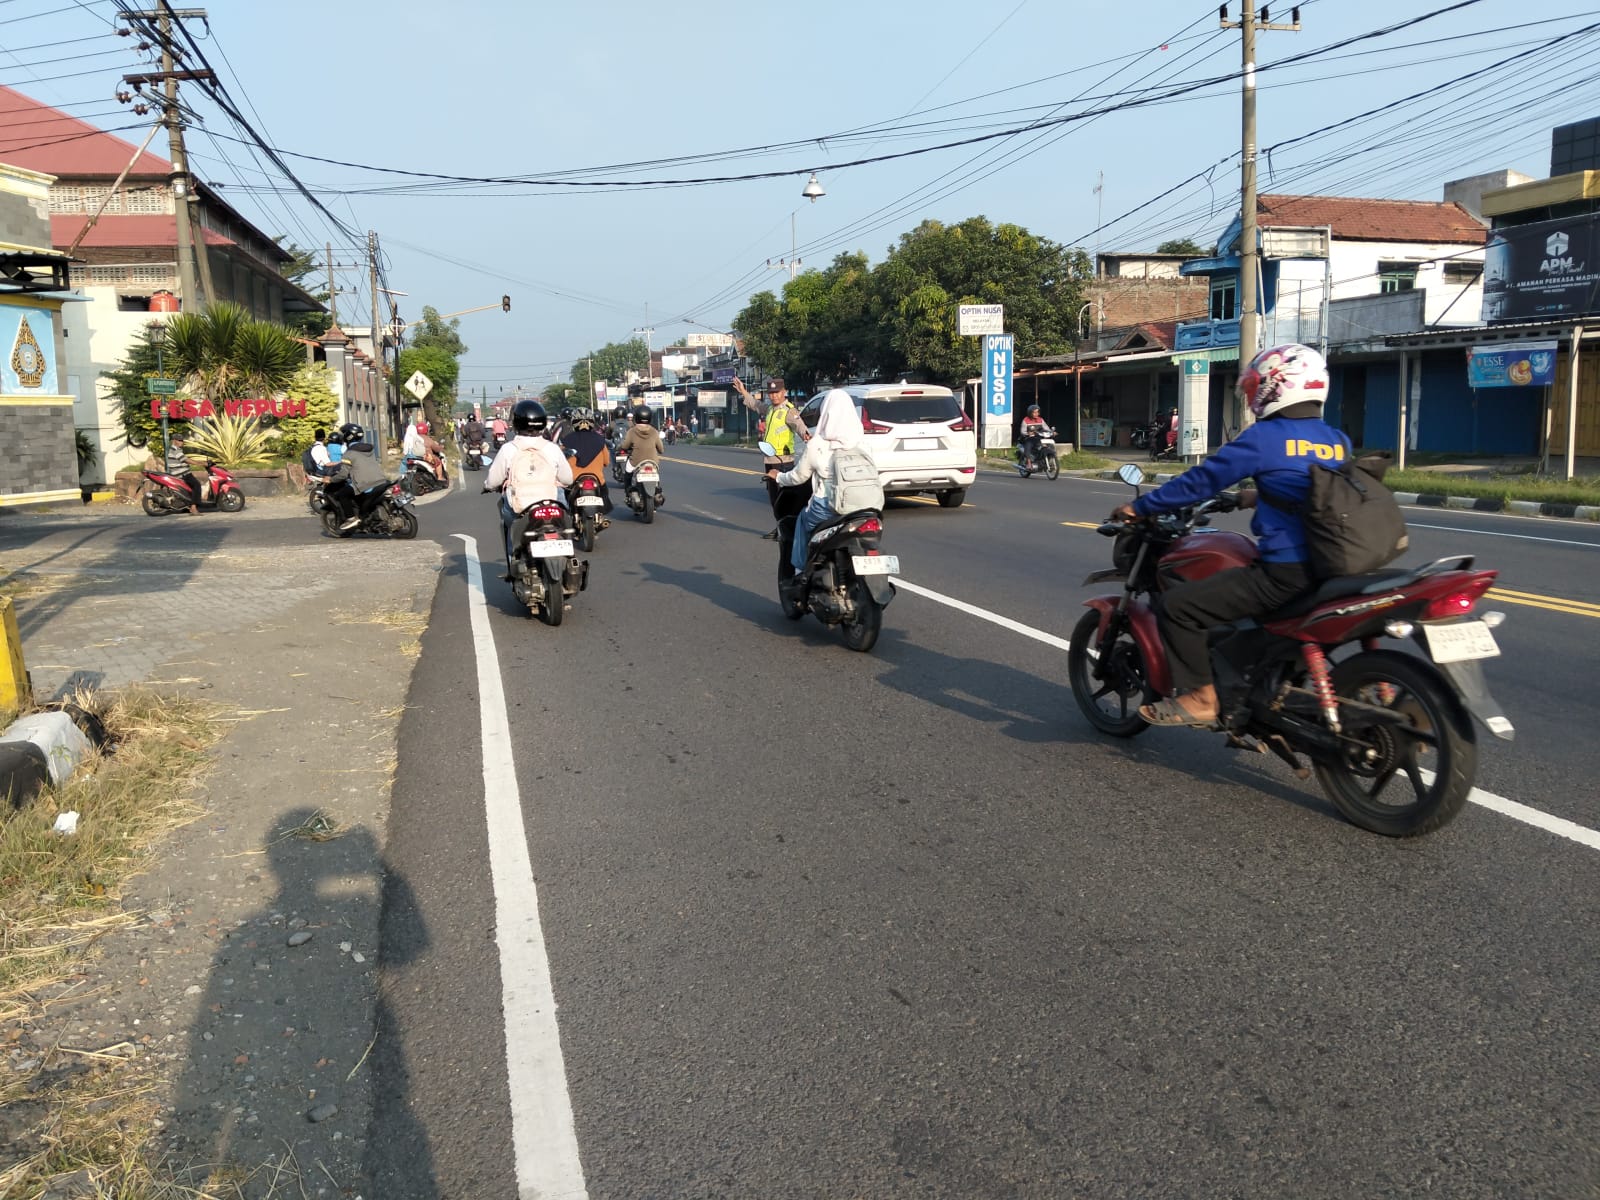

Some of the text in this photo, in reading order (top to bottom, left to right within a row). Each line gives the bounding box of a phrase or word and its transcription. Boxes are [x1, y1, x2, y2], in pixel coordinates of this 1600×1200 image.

[1540, 257, 1573, 272] APM
[961, 306, 1002, 315] OPTIK NUSA
[988, 336, 1011, 350] OPTIK
[1483, 355, 1505, 367] ESSE
[992, 351, 1006, 405] NUSA
[150, 398, 307, 419] DESA KEPUH
